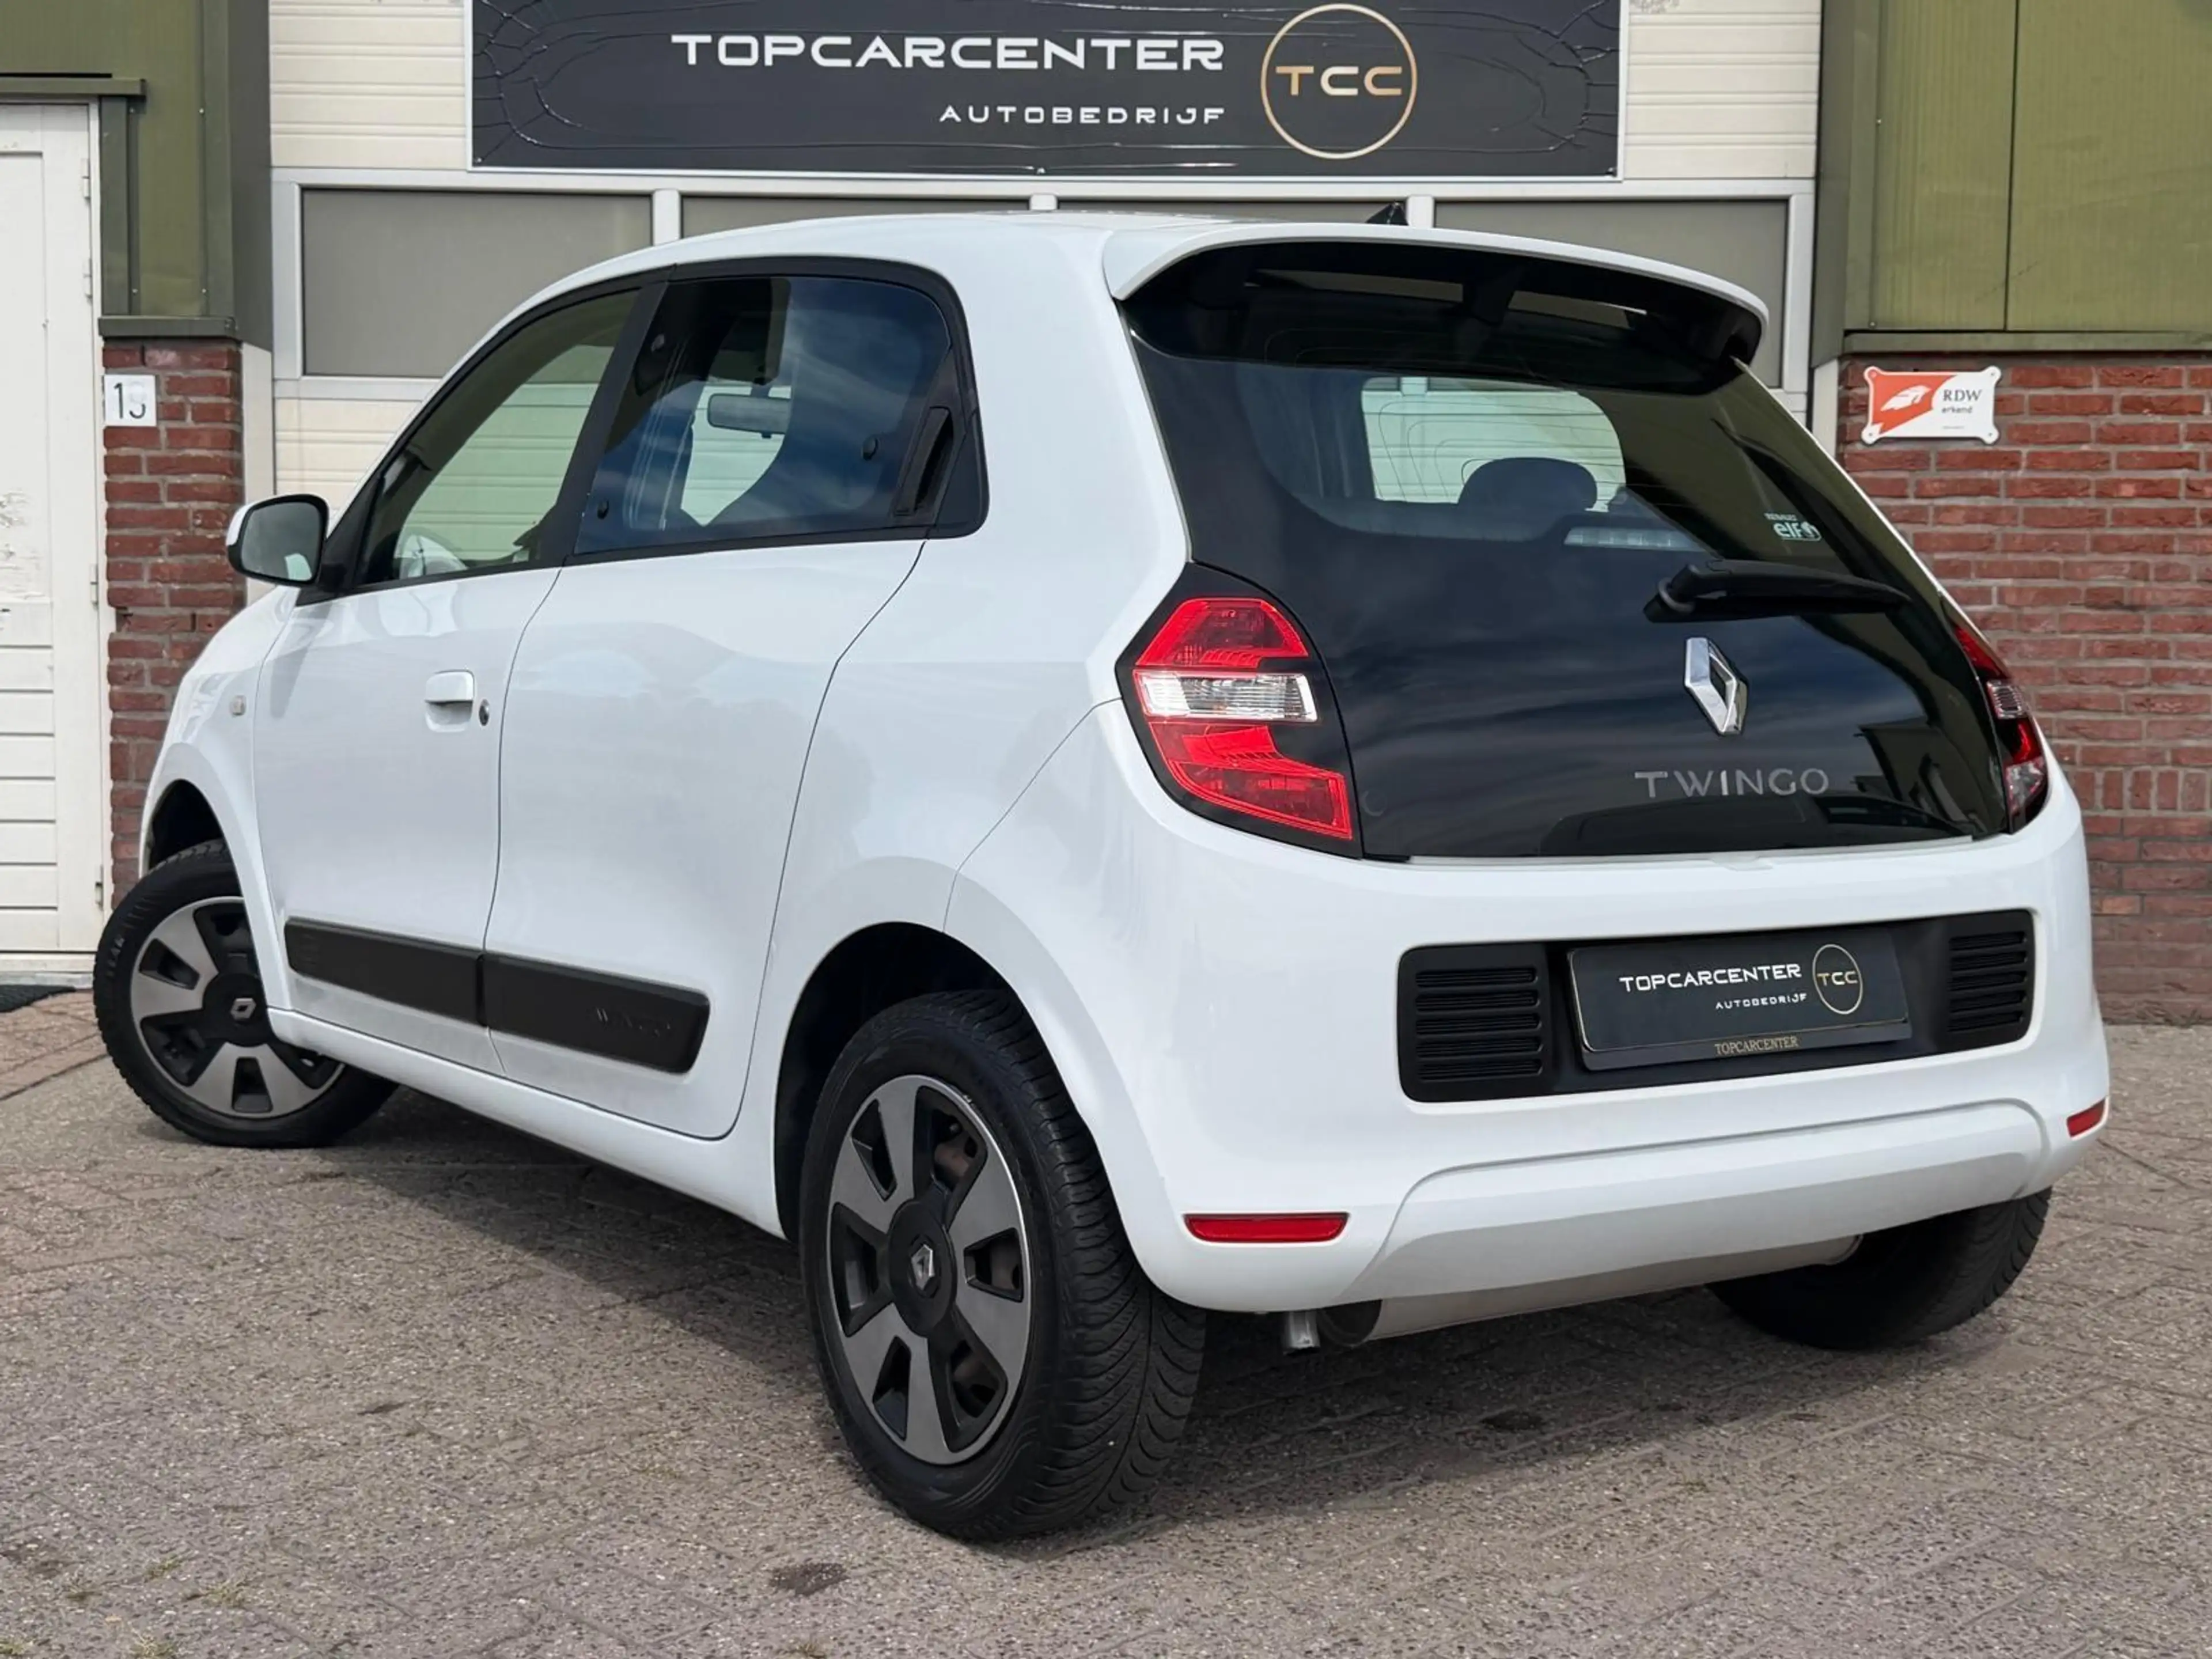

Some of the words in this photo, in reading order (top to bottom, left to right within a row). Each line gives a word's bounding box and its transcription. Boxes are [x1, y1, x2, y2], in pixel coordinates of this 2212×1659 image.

[672, 34, 1225, 70] TOPCARCENTER
[1276, 66, 1402, 96] TCC
[940, 105, 1225, 124] AUTOBEDRIJF
[1943, 389, 1982, 402] RDW
[1634, 768, 1830, 798] TWINGO
[1619, 963, 1802, 992] TOPCARCENTER
[1817, 971, 1858, 986] TCC
[1715, 993, 1807, 1009] AUTOBEDRIJF
[1714, 1036, 1799, 1055] TOPCARCENTER
